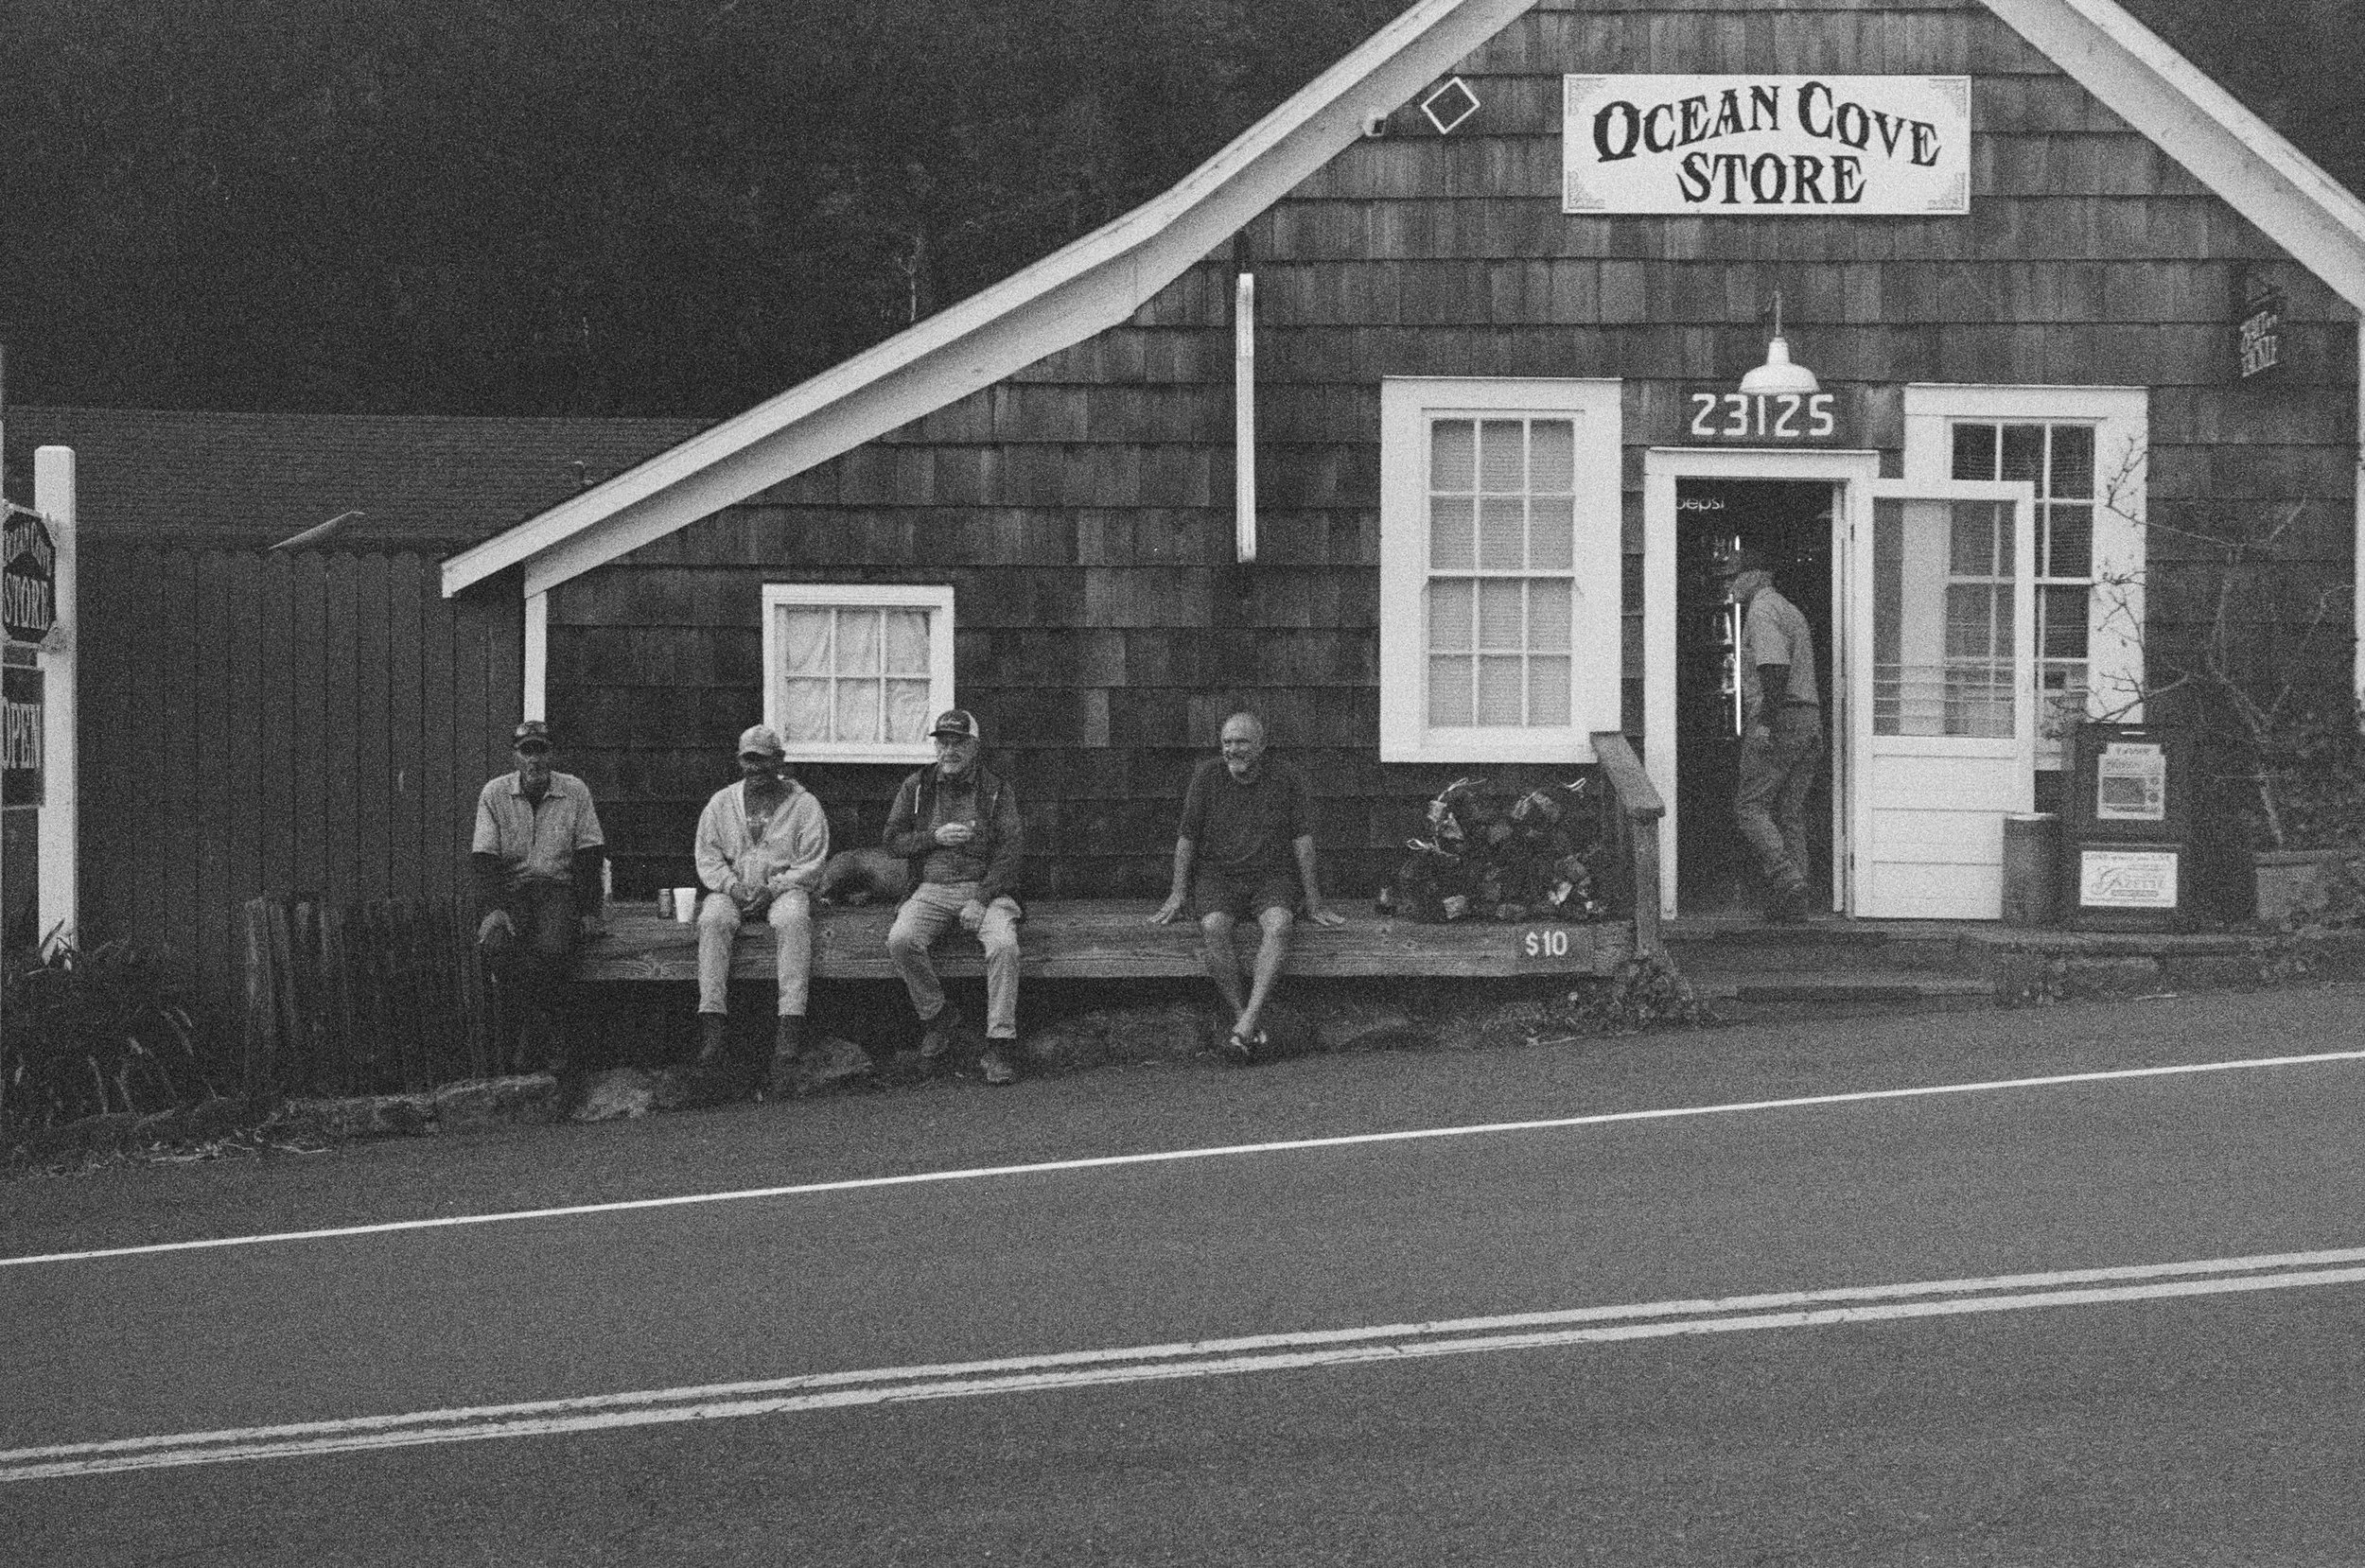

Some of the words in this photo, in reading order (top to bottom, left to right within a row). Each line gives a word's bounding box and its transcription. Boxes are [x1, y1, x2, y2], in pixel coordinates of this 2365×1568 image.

[1592, 85, 1780, 163] OCEAN
[1796, 81, 1941, 166] COVE
[1676, 151, 1867, 204] STORE
[1691, 392, 1835, 437] 23125
[4, 571, 48, 631] STORE
[3, 696, 41, 770] OPEN
[1525, 930, 1568, 956] $10
